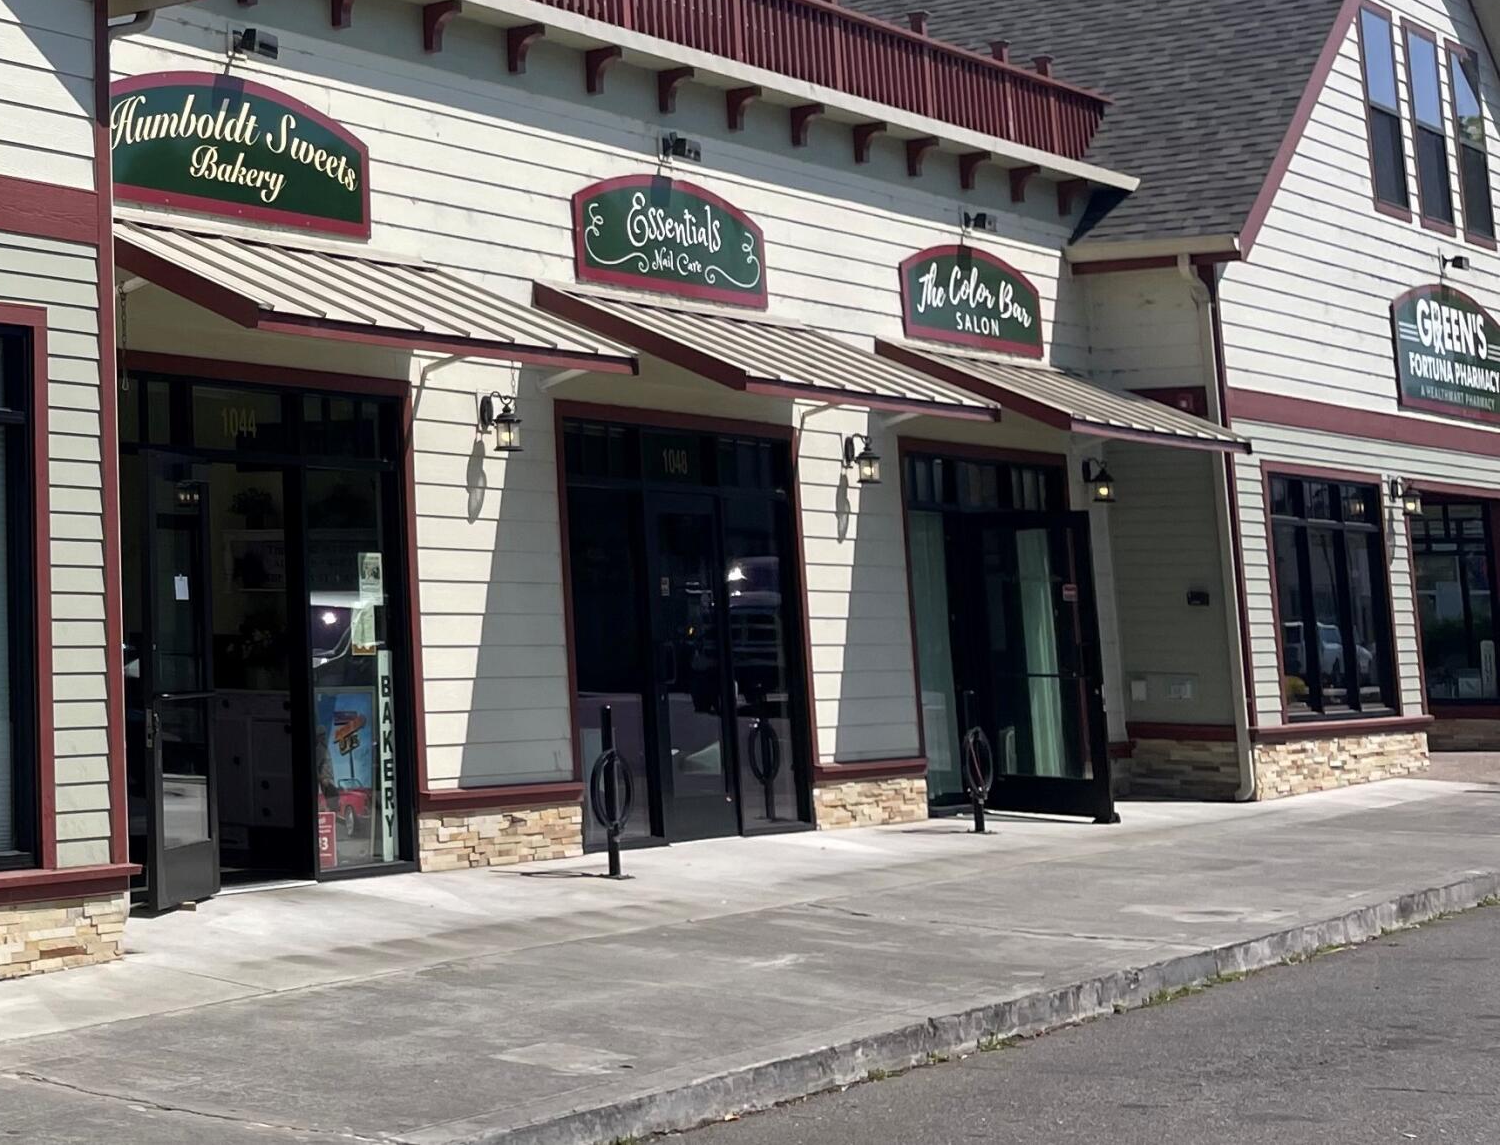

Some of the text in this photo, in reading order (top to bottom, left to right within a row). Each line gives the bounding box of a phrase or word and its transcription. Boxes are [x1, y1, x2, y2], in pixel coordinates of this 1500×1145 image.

[111, 93, 358, 192] Humboldt Sweets
[190, 145, 287, 203] Bakery
[627, 192, 721, 253] Essentials
[652, 247, 702, 275] Nail Care
[916, 262, 1032, 328] The Color Bar
[956, 312, 1000, 337] SALON
[1416, 298, 1488, 360] GREEN'S
[1409, 351, 1500, 394] FORTUNA PHARMACY
[221, 406, 258, 439] 1044
[381, 676, 394, 837] BAKERY
